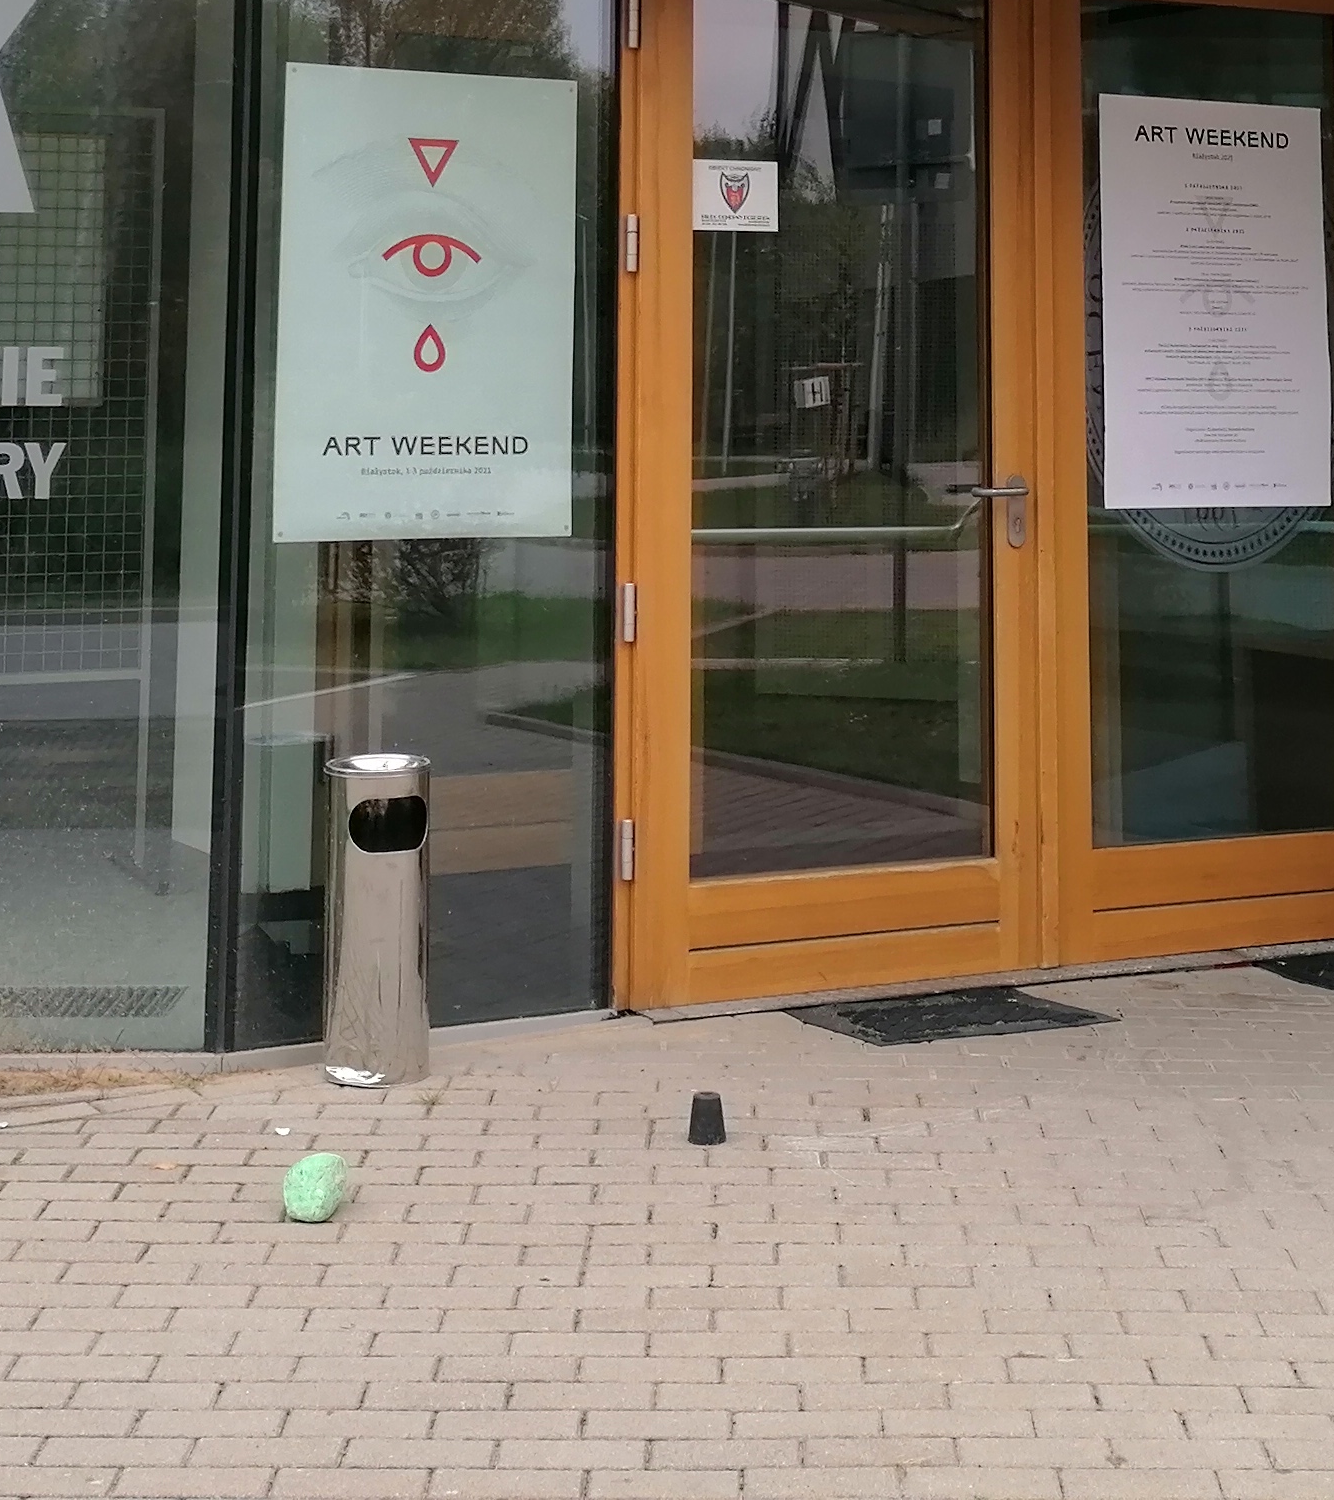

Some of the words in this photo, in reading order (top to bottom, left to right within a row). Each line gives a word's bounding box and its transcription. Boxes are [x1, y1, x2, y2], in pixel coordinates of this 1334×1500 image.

[1135, 124, 1178, 144] ART
[1185, 127, 1290, 149] WEEKEND
[322, 436, 381, 456] ART
[391, 435, 529, 456] WEEKEND
